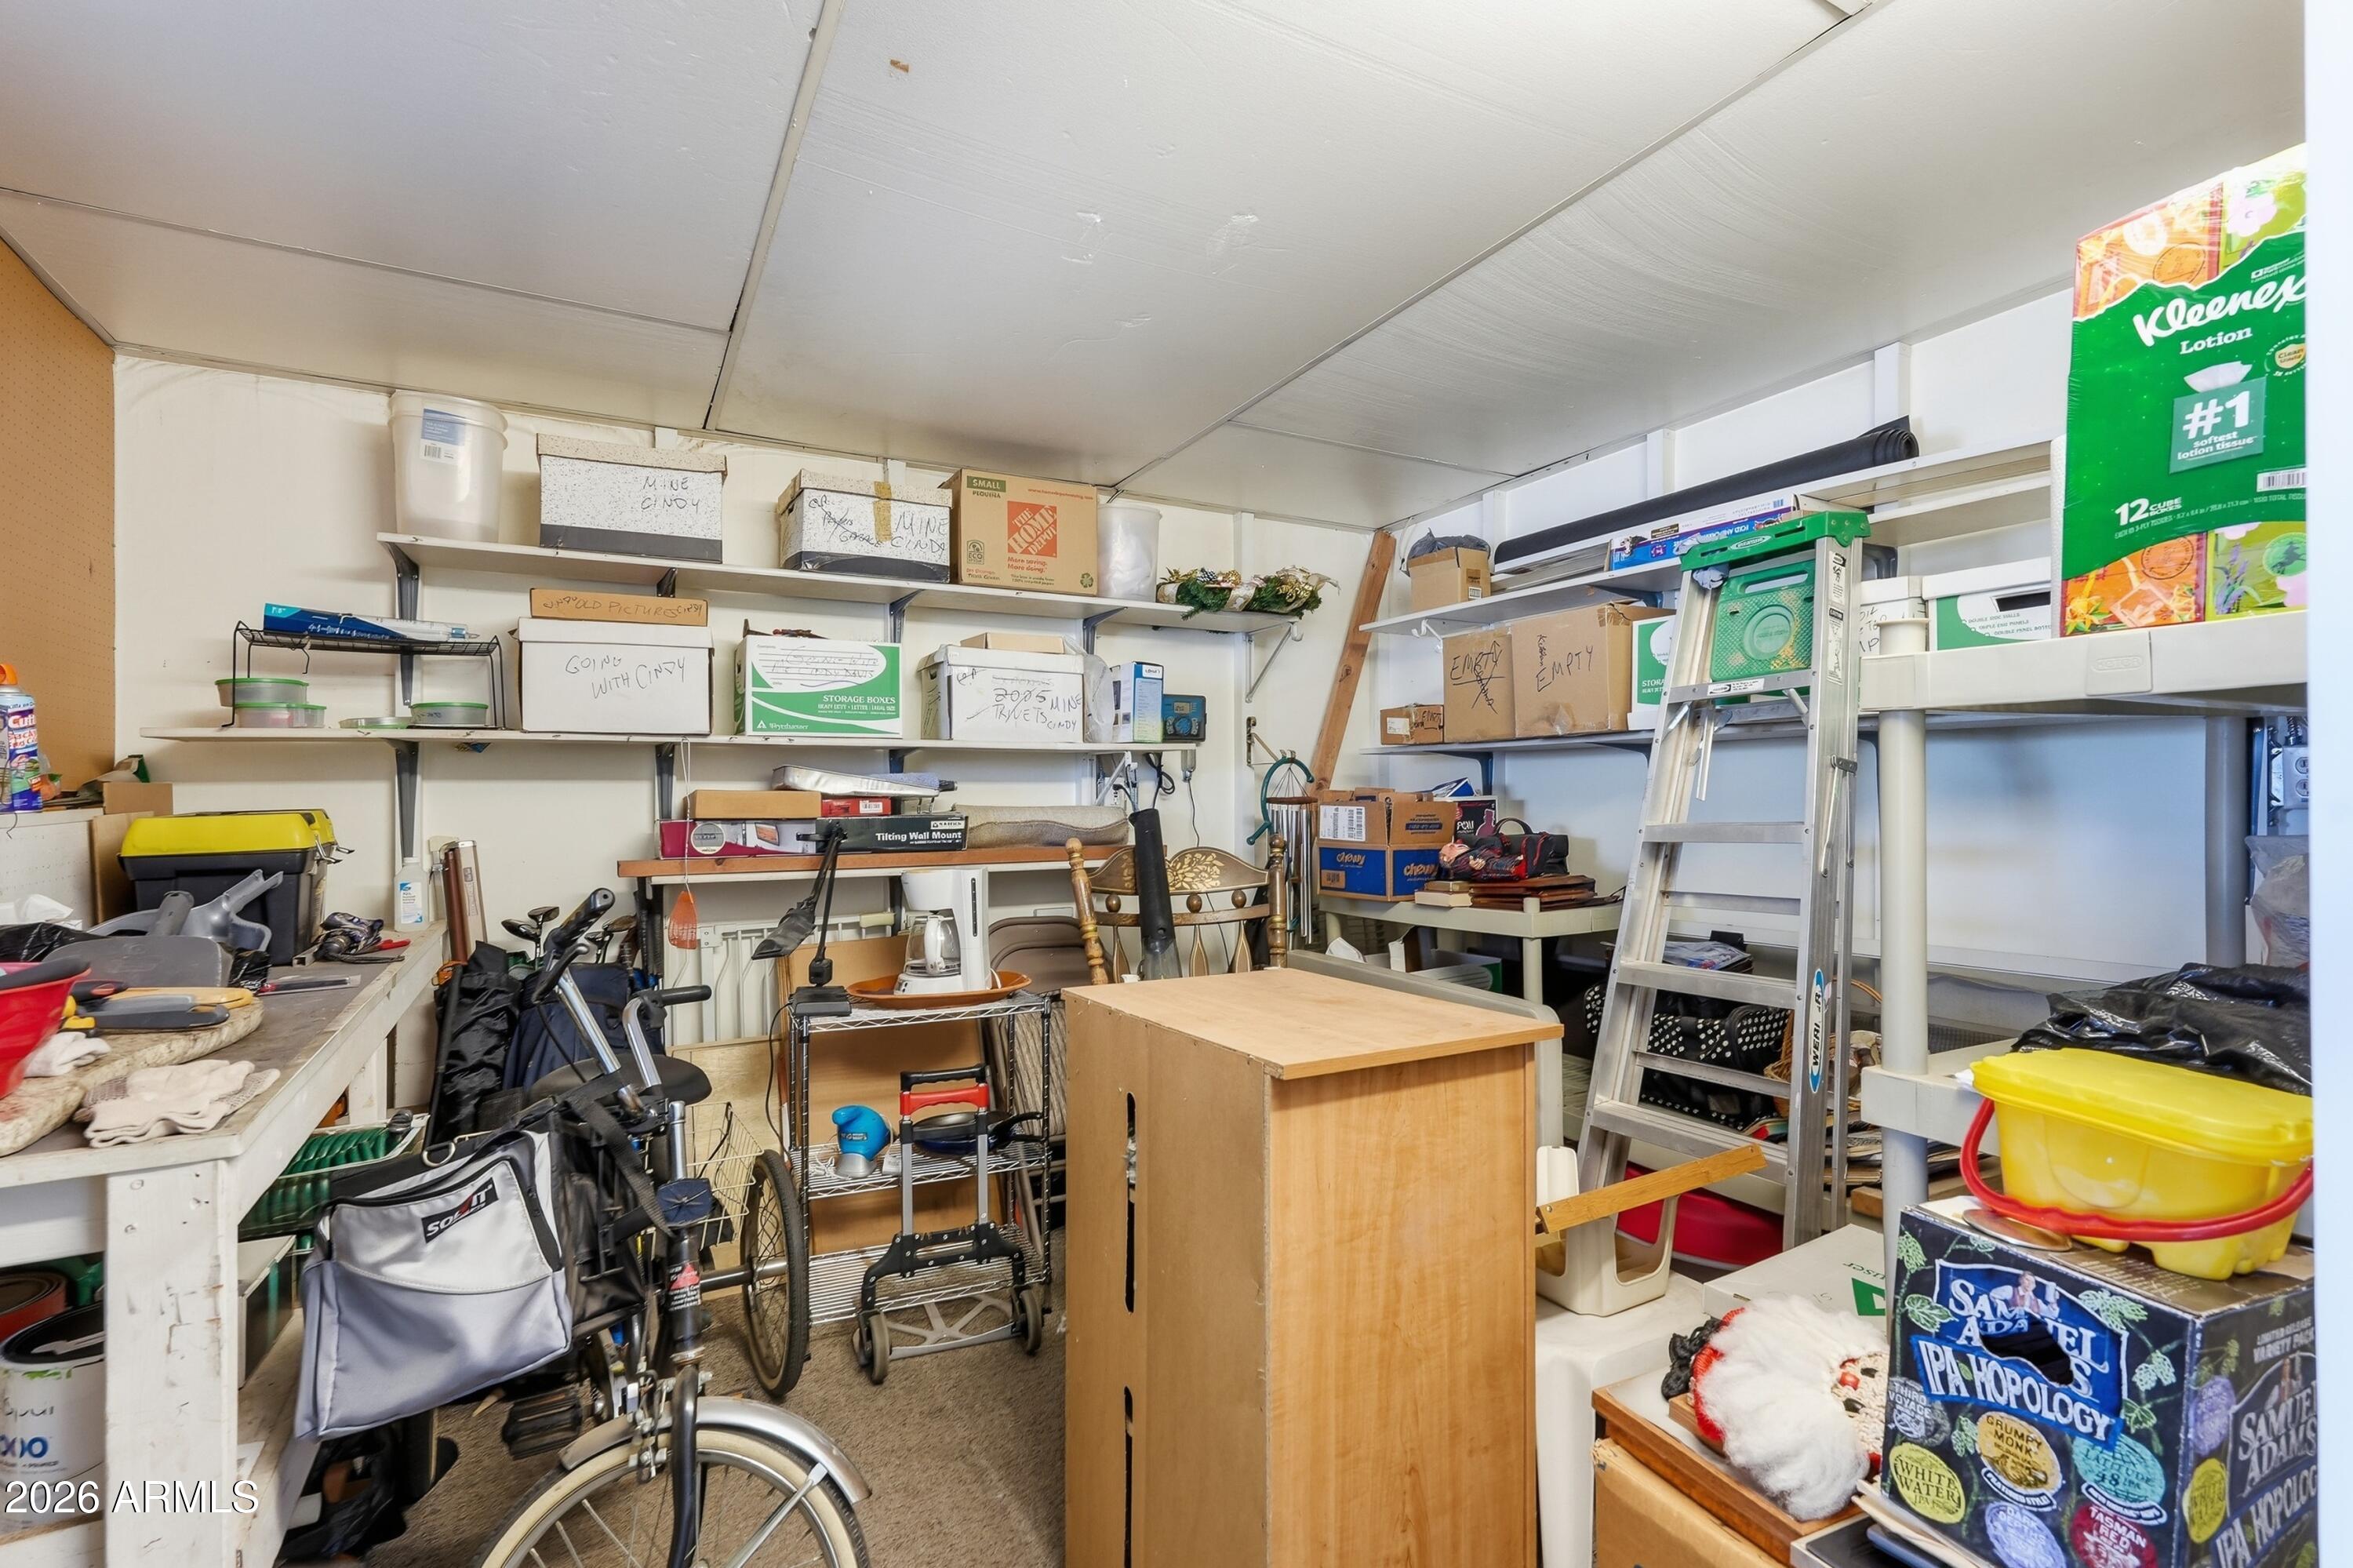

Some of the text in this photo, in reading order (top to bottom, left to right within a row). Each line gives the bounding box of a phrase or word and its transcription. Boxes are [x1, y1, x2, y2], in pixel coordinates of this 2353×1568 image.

[2133, 275, 2306, 347] Kleenex
[2180, 326, 2253, 355] Lotion
[2182, 391, 2250, 439] #1
[2177, 436, 2256, 461] lotion tissue
[2193, 431, 2238, 449] softest
[643, 476, 688, 491] MINE
[973, 479, 1000, 489] SMALL
[641, 497, 700, 515] CINDY
[2115, 498, 2150, 526] 12
[2148, 497, 2182, 510] CUBE
[895, 511, 949, 537] MINE
[1008, 504, 1056, 554] HOME
[1012, 508, 1034, 528] THE
[891, 536, 945, 558] CINDY
[1027, 524, 1056, 555] DEPOT
[575, 598, 602, 609] OLD
[566, 655, 621, 674] GOING
[591, 657, 686, 699] WITH CINDY
[1450, 649, 1502, 681] EMPTY
[1537, 646, 1594, 693] EMPTY
[823, 694, 896, 704] STORAGE BOXES
[1050, 693, 1083, 713] MINE
[1047, 719, 1077, 731] CINDY
[876, 831, 907, 842] Tilting
[909, 831, 929, 840] Wall
[1949, 1279, 2109, 1373] SAMEL
[2253, 1335, 2291, 1363] VARIETY
[1889, 1391, 1933, 1419] VOYAGE
[1894, 1382, 1927, 1405] THIRD
[1918, 1340, 2116, 1442] IPA HOPOLOGY
[1987, 1414, 2042, 1449] GRUMPY
[1994, 1430, 2034, 1458] MONK
[1899, 1458, 1957, 1490] WHITE
[2083, 1448, 2155, 1486] LATITUDE
[2095, 1470, 2120, 1486] 48
[1897, 1475, 1961, 1505] WATER
[2089, 1505, 2148, 1548] TASMAN
[2215, 1517, 2252, 1568] IPA
[2250, 1464, 2317, 1553] HOPOLOG
[2099, 1524, 2131, 1550] RED
